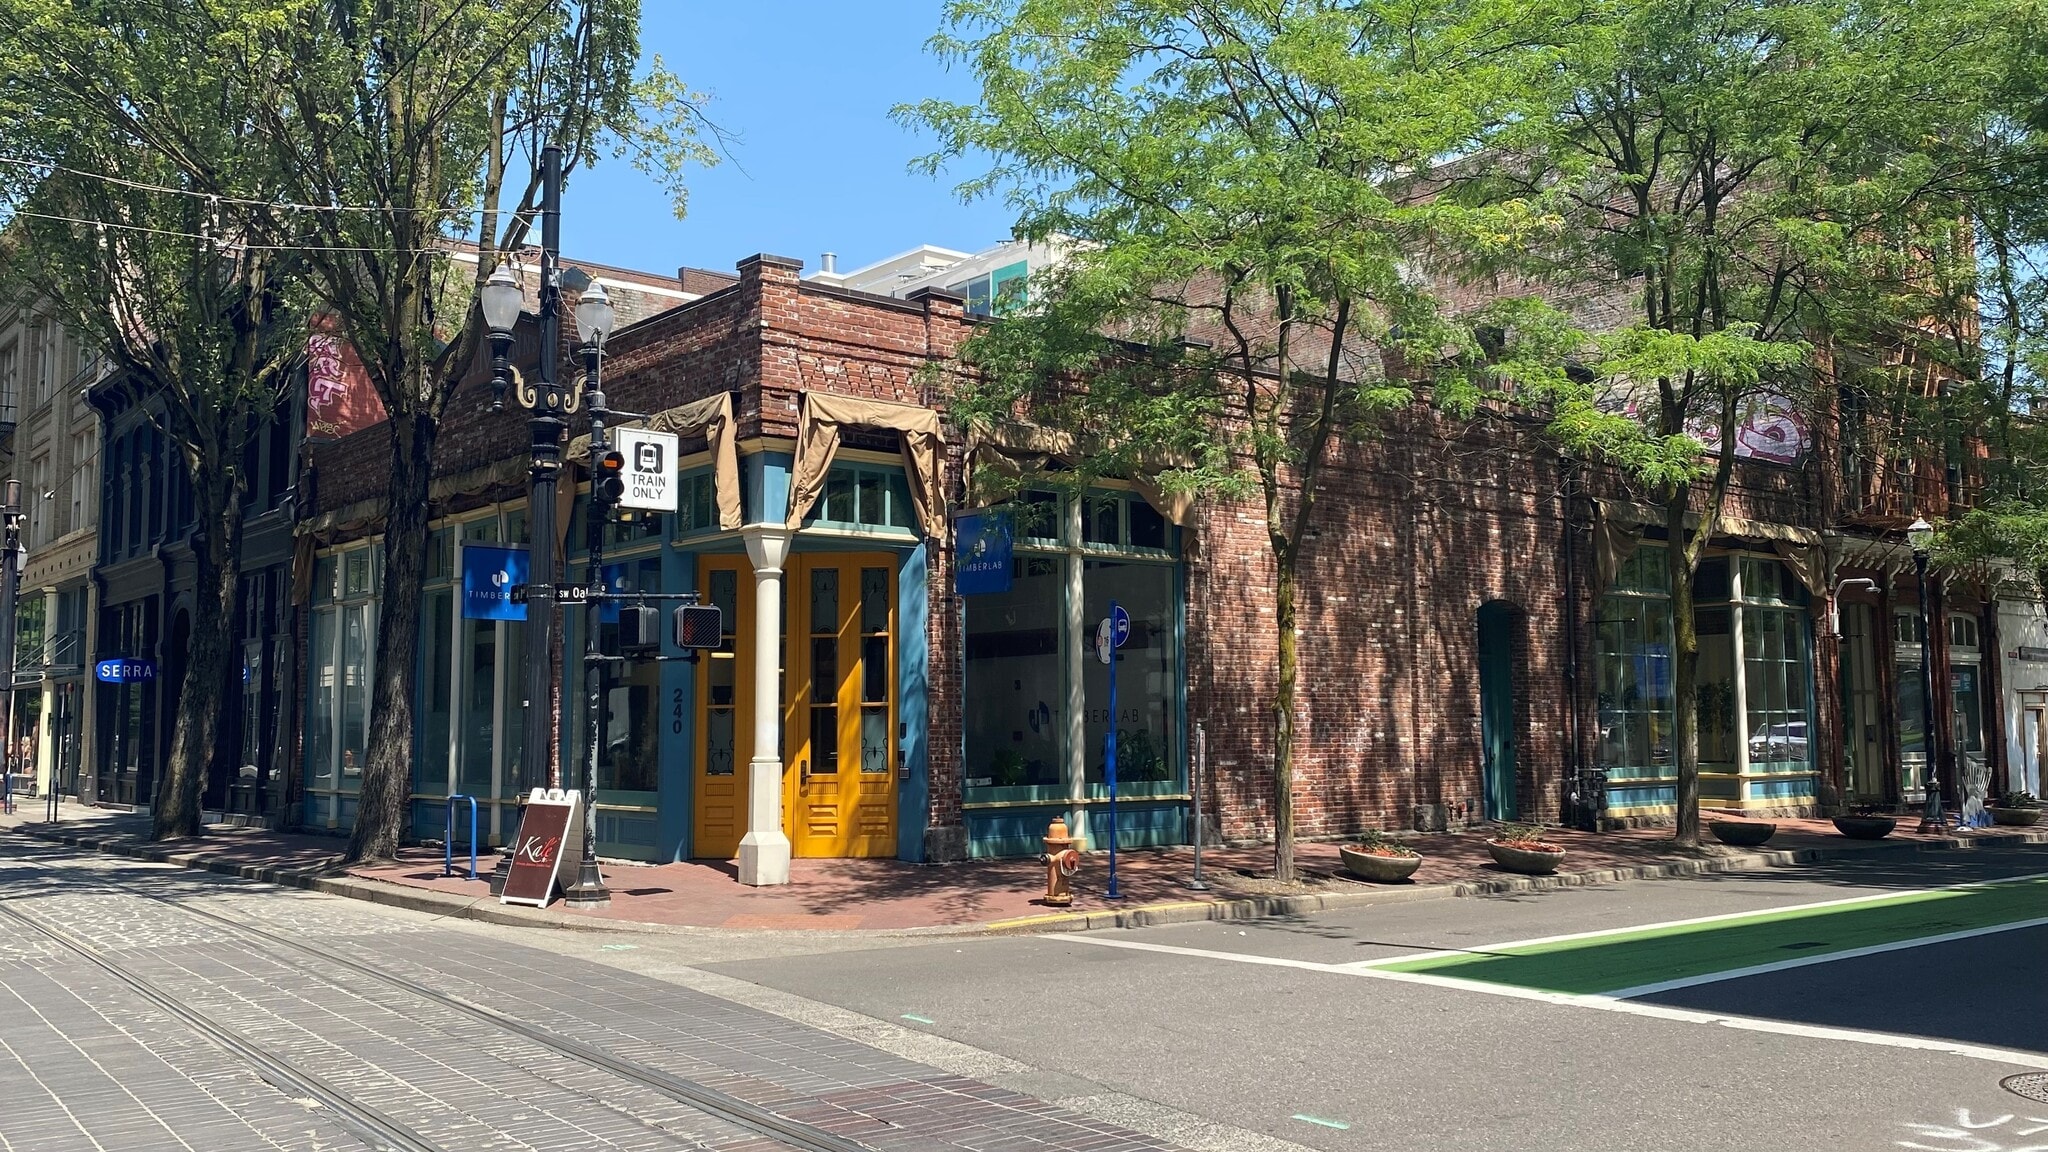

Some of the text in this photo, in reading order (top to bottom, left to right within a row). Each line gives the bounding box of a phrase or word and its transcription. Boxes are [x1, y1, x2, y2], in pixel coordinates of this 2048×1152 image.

[631, 473, 666, 488] TRAIN
[632, 486, 663, 500] ONLY
[468, 590, 511, 600] TIMBER
[101, 664, 152, 678] SERRA
[672, 687, 683, 734] 240
[1054, 708, 1139, 723] TBERAB
